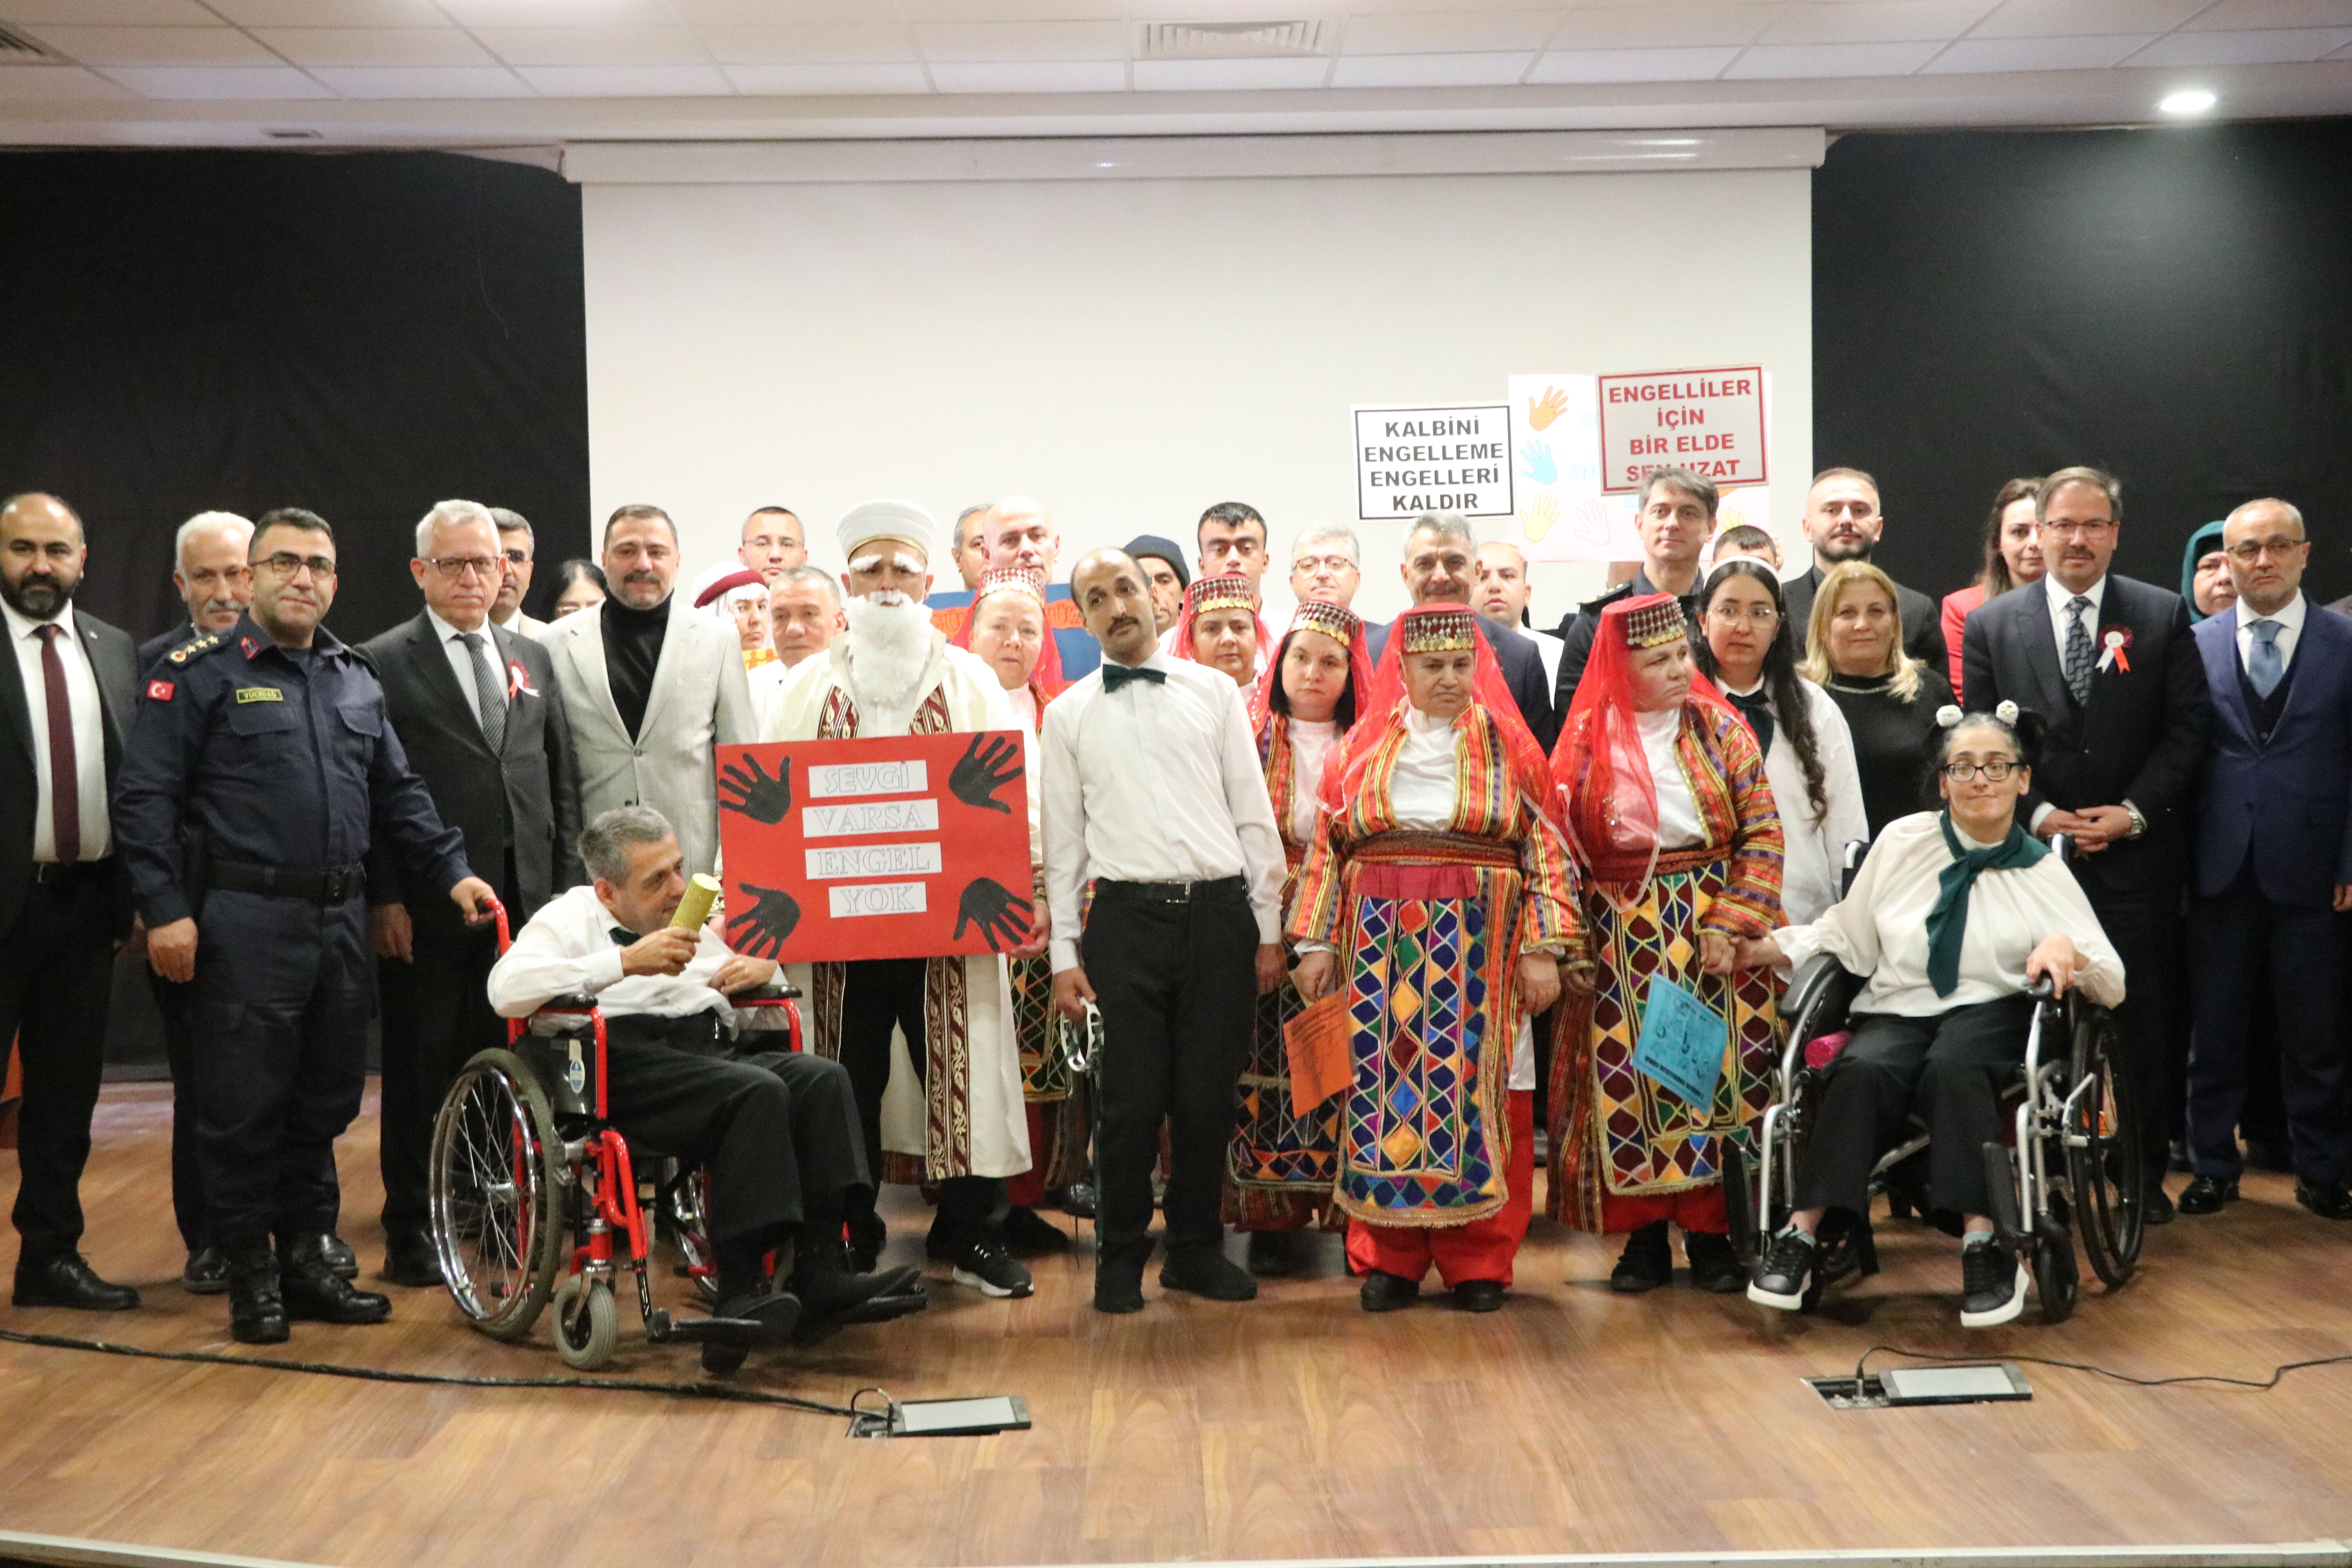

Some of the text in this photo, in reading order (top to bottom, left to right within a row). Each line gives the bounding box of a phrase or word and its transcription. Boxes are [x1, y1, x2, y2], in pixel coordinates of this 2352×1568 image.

[1609, 378, 1751, 403] ENGELLİLER
[1385, 416, 1478, 437] KALBİNİ
[1658, 405, 1705, 430] İÇİN
[1365, 444, 1503, 462] ENGELLEME
[1630, 433, 1735, 455] BİR ELDE
[1371, 463, 1498, 486] ENGELLERİ
[1393, 494, 1478, 511] KALDIR
[825, 760, 909, 793] SEVGİ
[813, 804, 926, 833] VARSA
[817, 846, 930, 876] ENGEL
[840, 885, 916, 914] YOK
